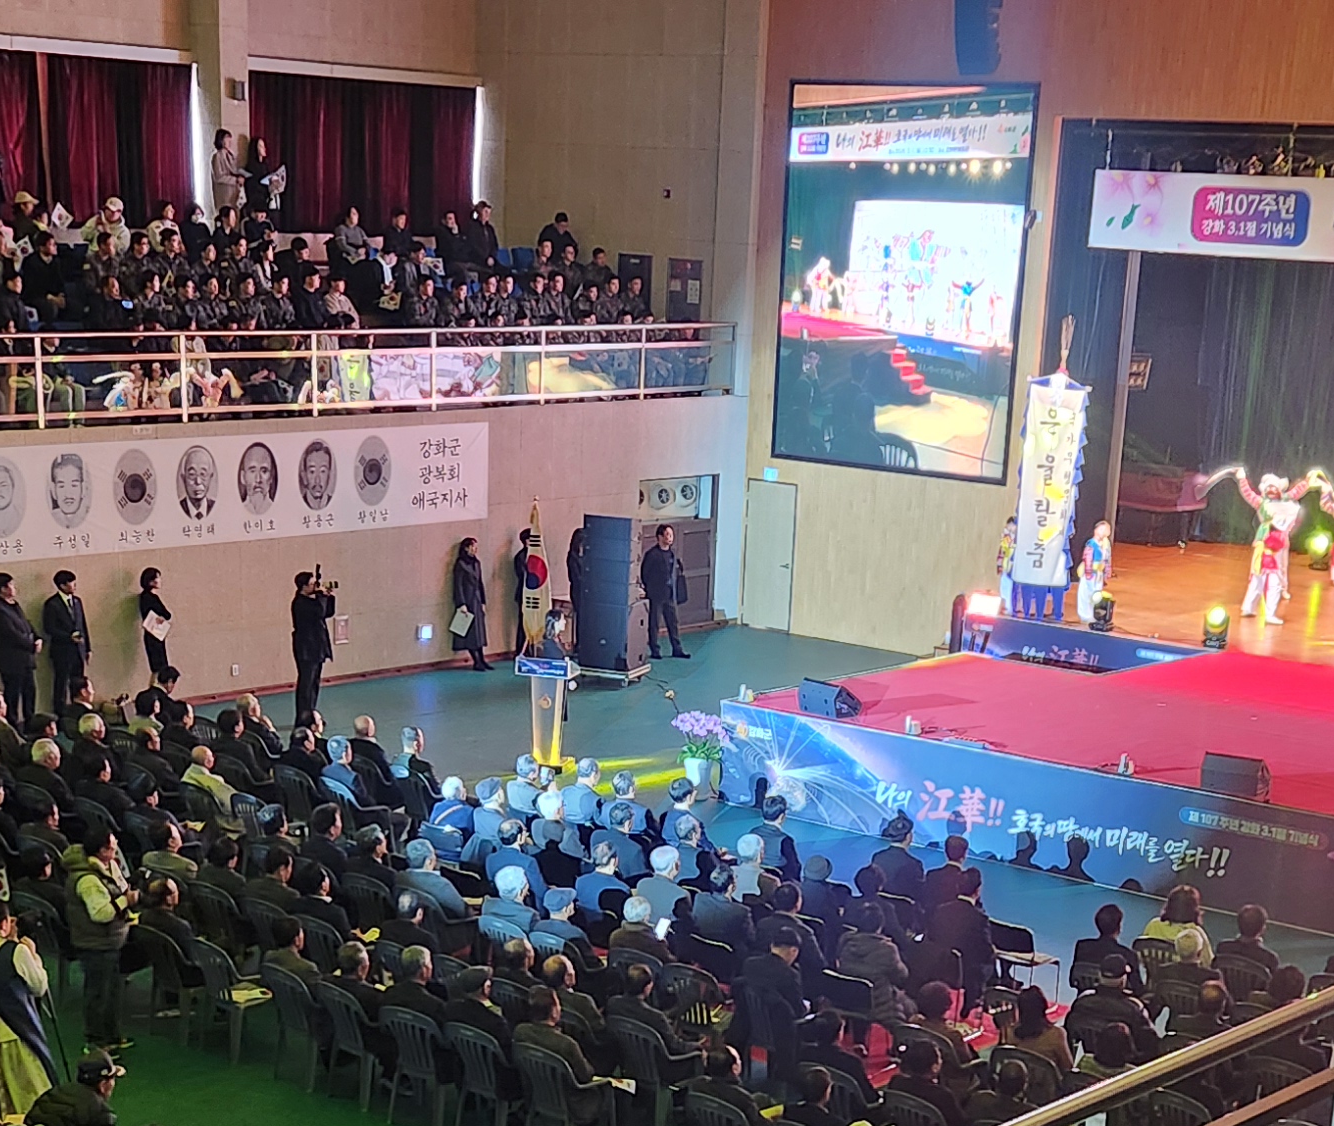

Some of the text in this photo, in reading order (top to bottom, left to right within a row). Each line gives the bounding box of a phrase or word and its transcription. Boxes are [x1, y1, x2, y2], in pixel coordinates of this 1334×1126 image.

[1205, 191, 1296, 219] 제107주년
[1201, 219, 1225, 236] 강화
[1260, 221, 1295, 239] 기념식
[419, 438, 462, 459] 강화군
[419, 463, 460, 484] 광복회
[411, 488, 468, 510] 애국지사
[875, 780, 912, 808] 나의
[916, 779, 1005, 833] 江華!!
[1006, 807, 1056, 840] 호국의
[1105, 826, 1165, 863] 미래를
[1163, 839, 1230, 877] 열다!!
